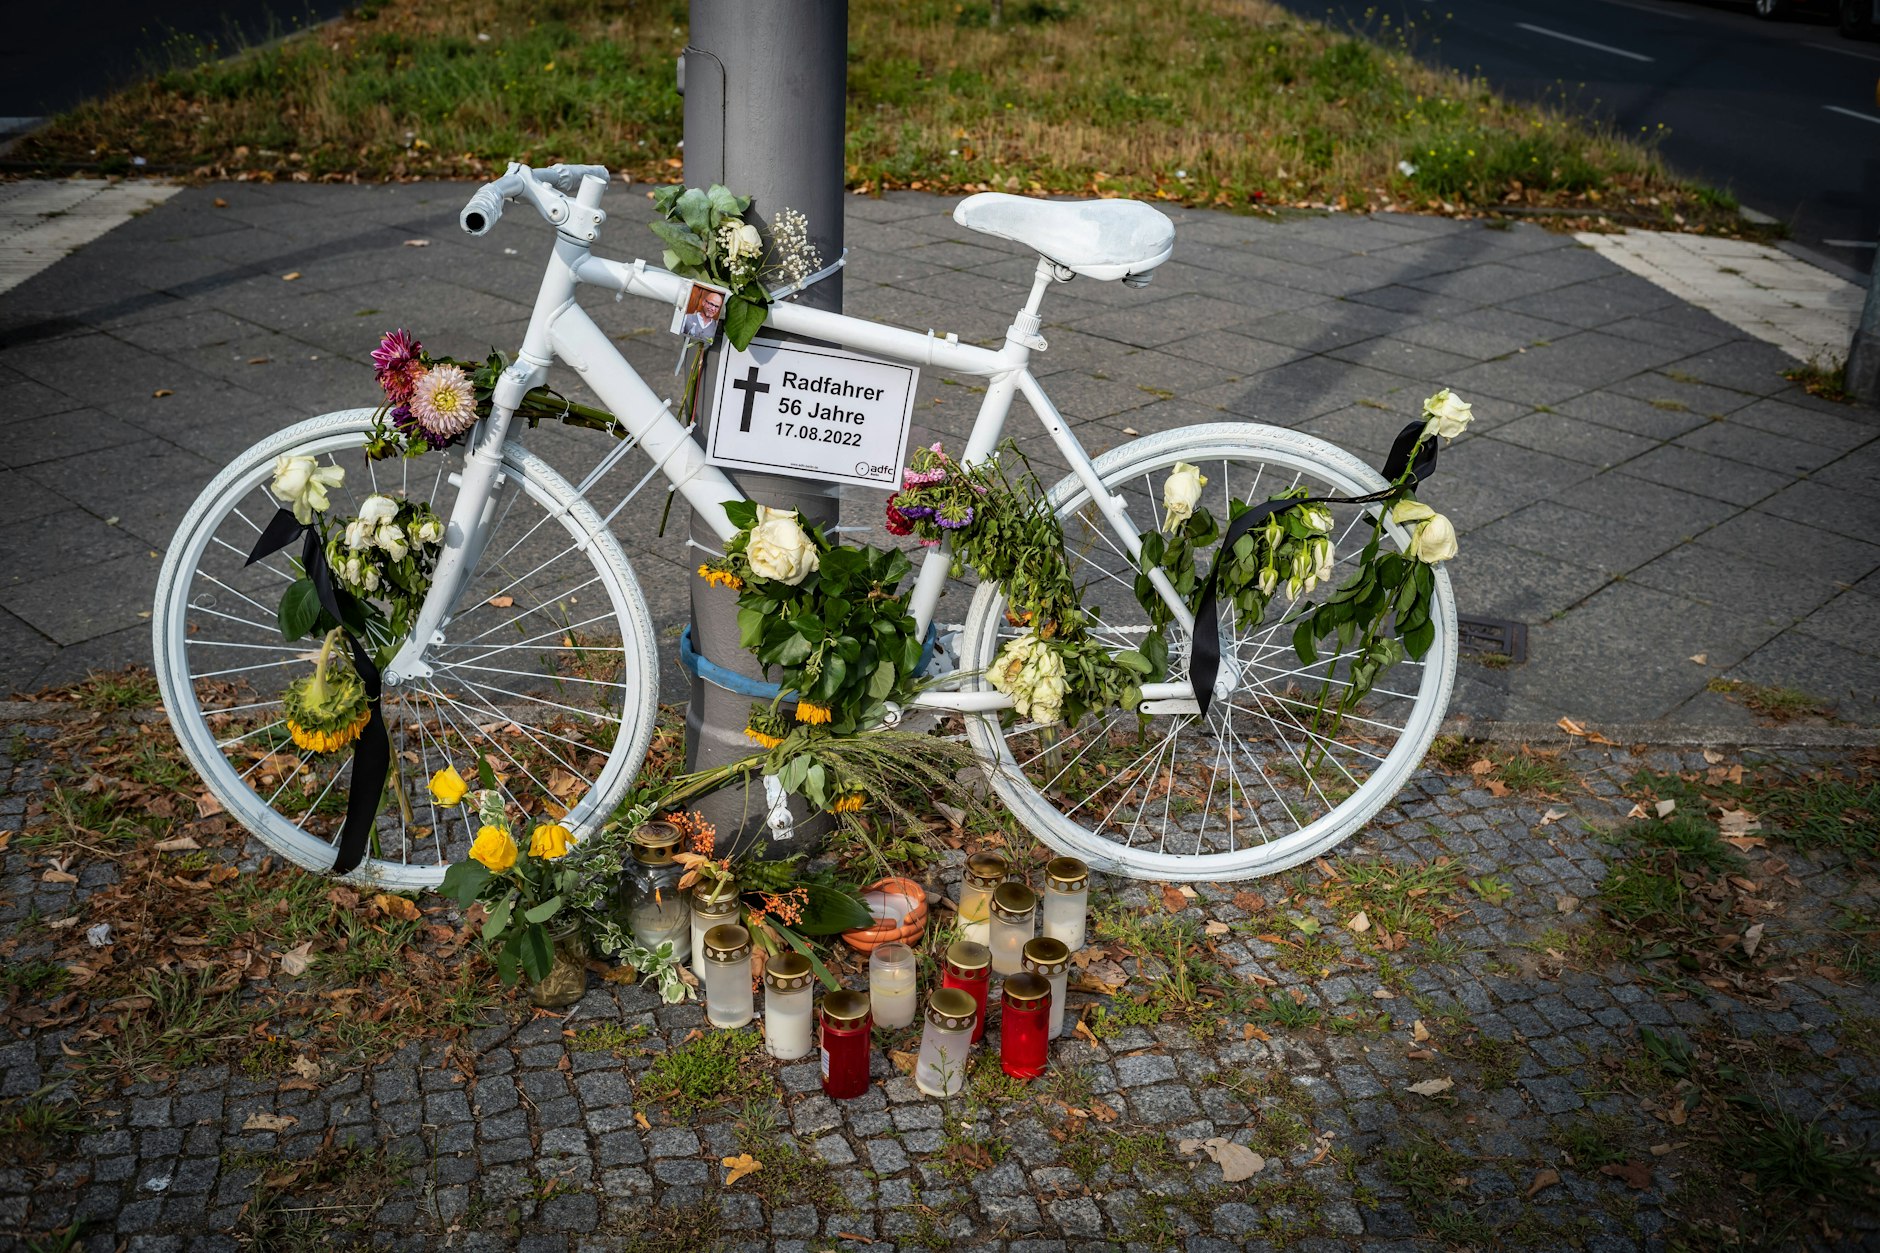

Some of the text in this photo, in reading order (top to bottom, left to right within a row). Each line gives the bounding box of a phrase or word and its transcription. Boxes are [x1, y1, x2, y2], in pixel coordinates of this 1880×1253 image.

[782, 371, 885, 401] Radfahrer
[778, 397, 865, 425] 56 Jahre
[775, 422, 862, 447] 17.08.2022
[870, 465, 894, 476] adfc
